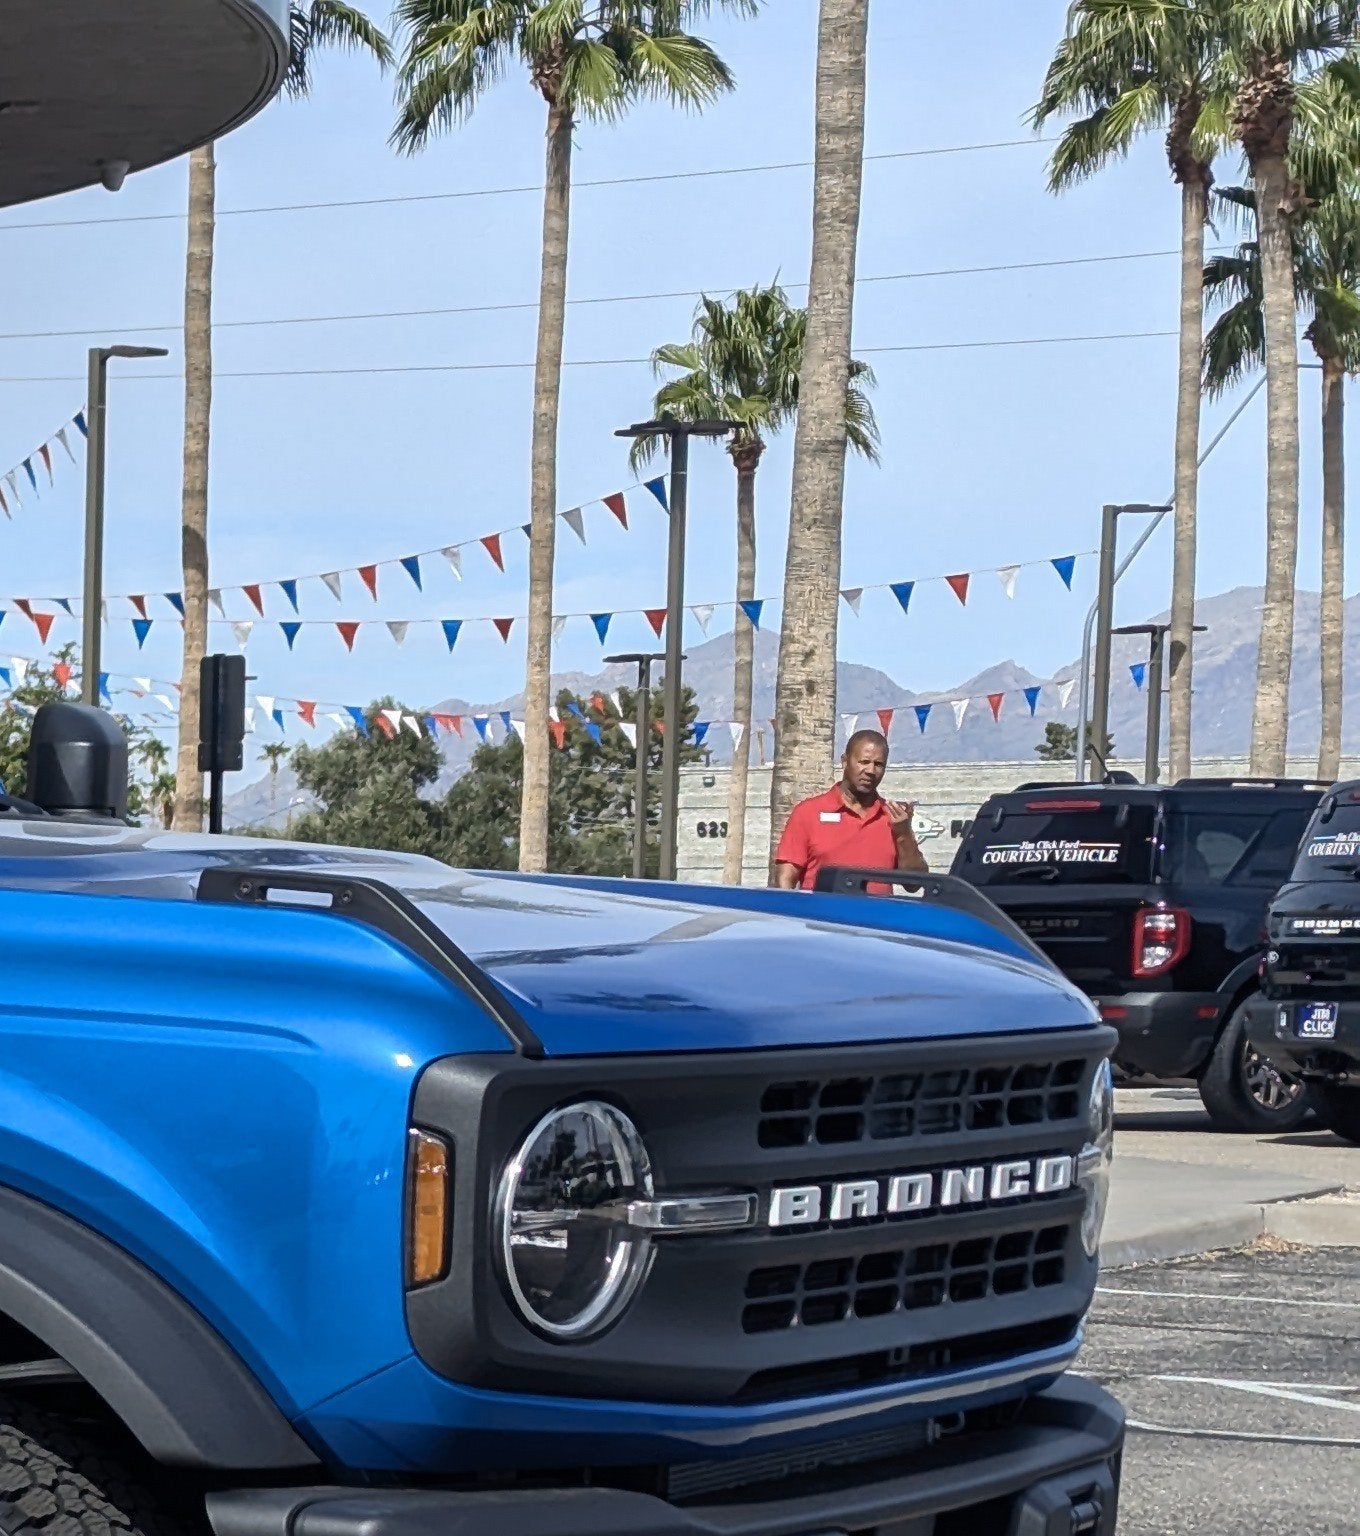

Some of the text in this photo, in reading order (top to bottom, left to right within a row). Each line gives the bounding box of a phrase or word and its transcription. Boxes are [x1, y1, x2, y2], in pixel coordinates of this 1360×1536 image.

[982, 849, 1118, 864] COURTESY VEHICLE
[769, 1155, 1073, 1227] BRONCO
